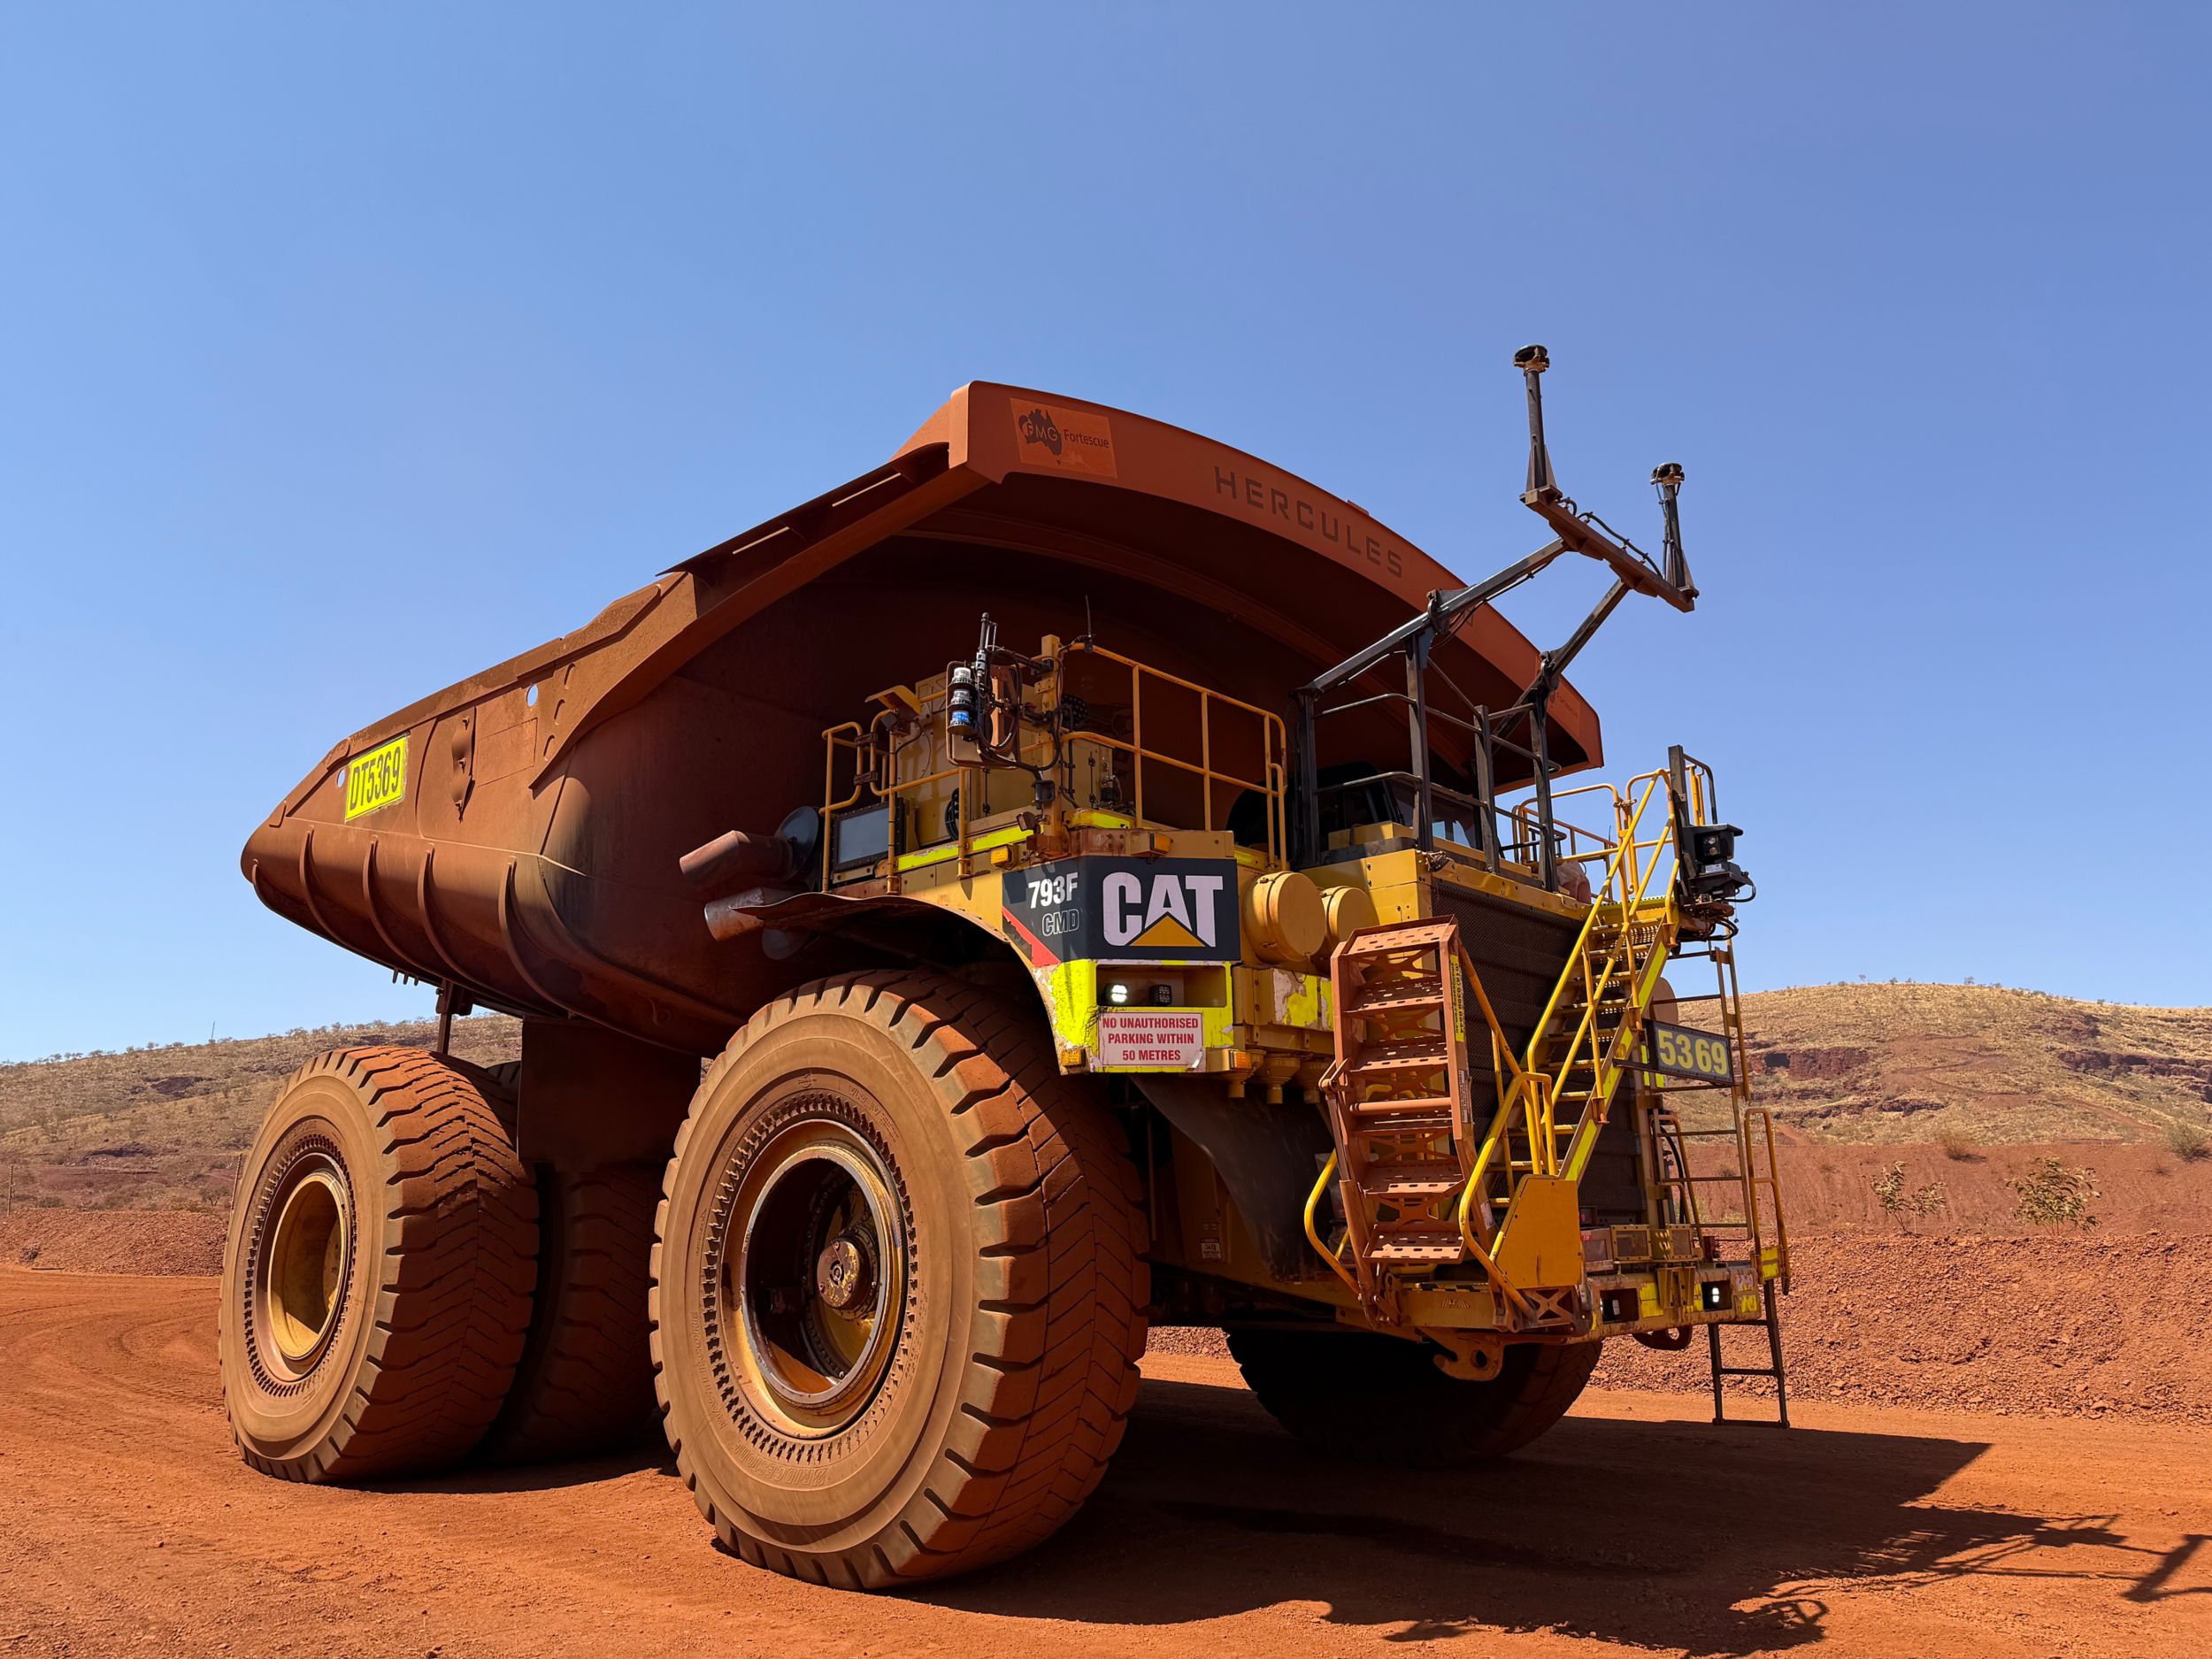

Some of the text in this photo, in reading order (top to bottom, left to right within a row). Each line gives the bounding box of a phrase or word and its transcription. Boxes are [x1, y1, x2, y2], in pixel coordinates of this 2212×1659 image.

[1026, 422, 1110, 449] FMG Fortescue
[1214, 465, 1402, 579] HERCULES
[349, 746, 401, 811] DT5369
[1028, 872, 1078, 909] 793F
[1041, 909, 1079, 937] CMD
[1102, 872, 1223, 948] CAT
[1102, 1018, 1198, 1029] NO UNAUTHORISED
[1108, 1033, 1194, 1044] PARKING WITHIN
[1122, 1049, 1181, 1061] 50 METRES
[1658, 1030, 1728, 1076] 5369
